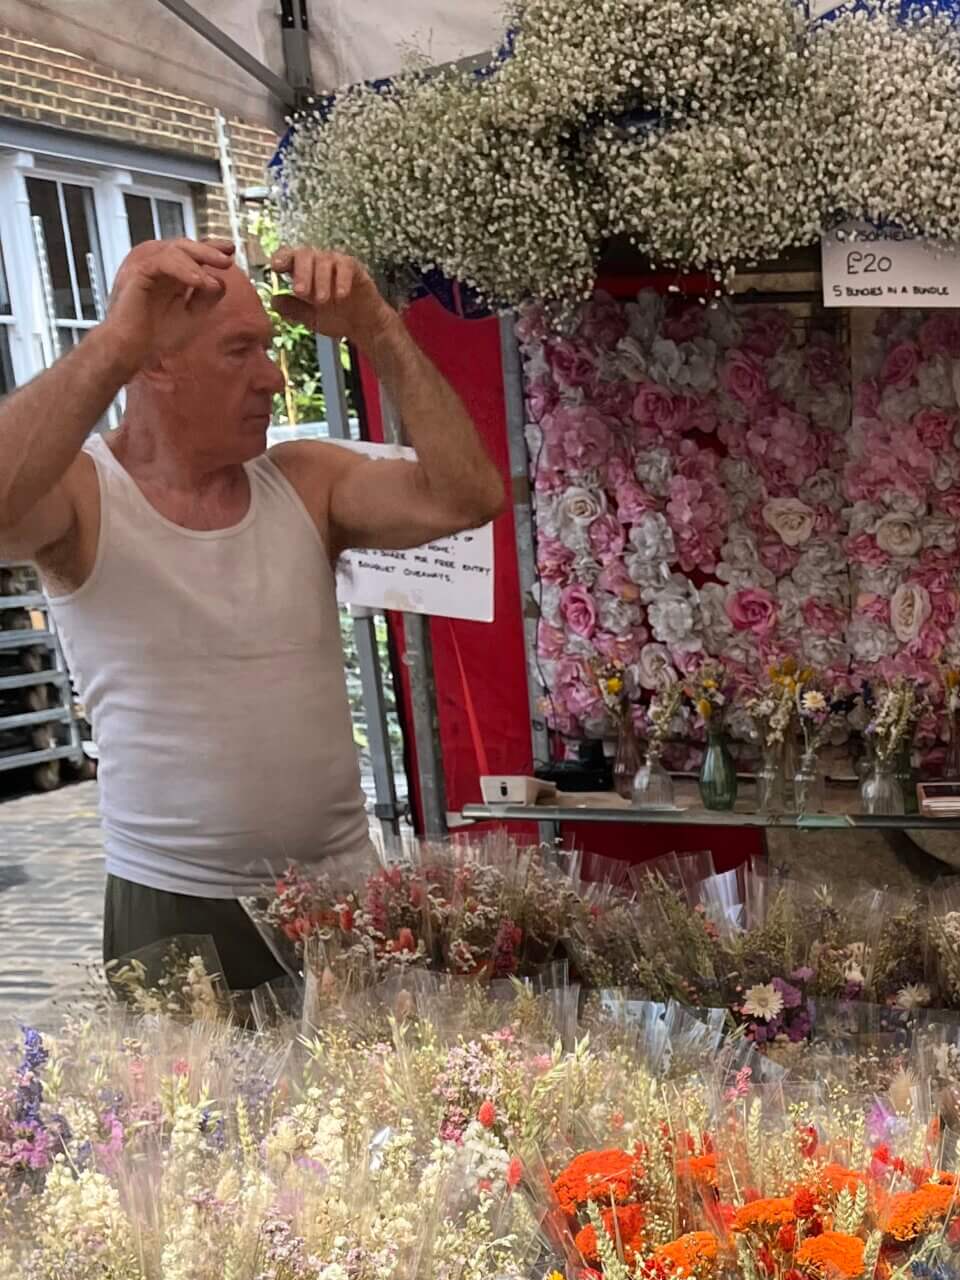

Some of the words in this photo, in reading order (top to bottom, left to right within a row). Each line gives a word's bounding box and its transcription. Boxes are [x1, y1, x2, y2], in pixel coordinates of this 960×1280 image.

[847, 251, 892, 275] £20
[832, 284, 842, 297] 5
[887, 286, 897, 294] IN
[901, 285, 908, 294] A
[434, 558, 456, 569] FREE
[462, 563, 492, 577] ENTRY
